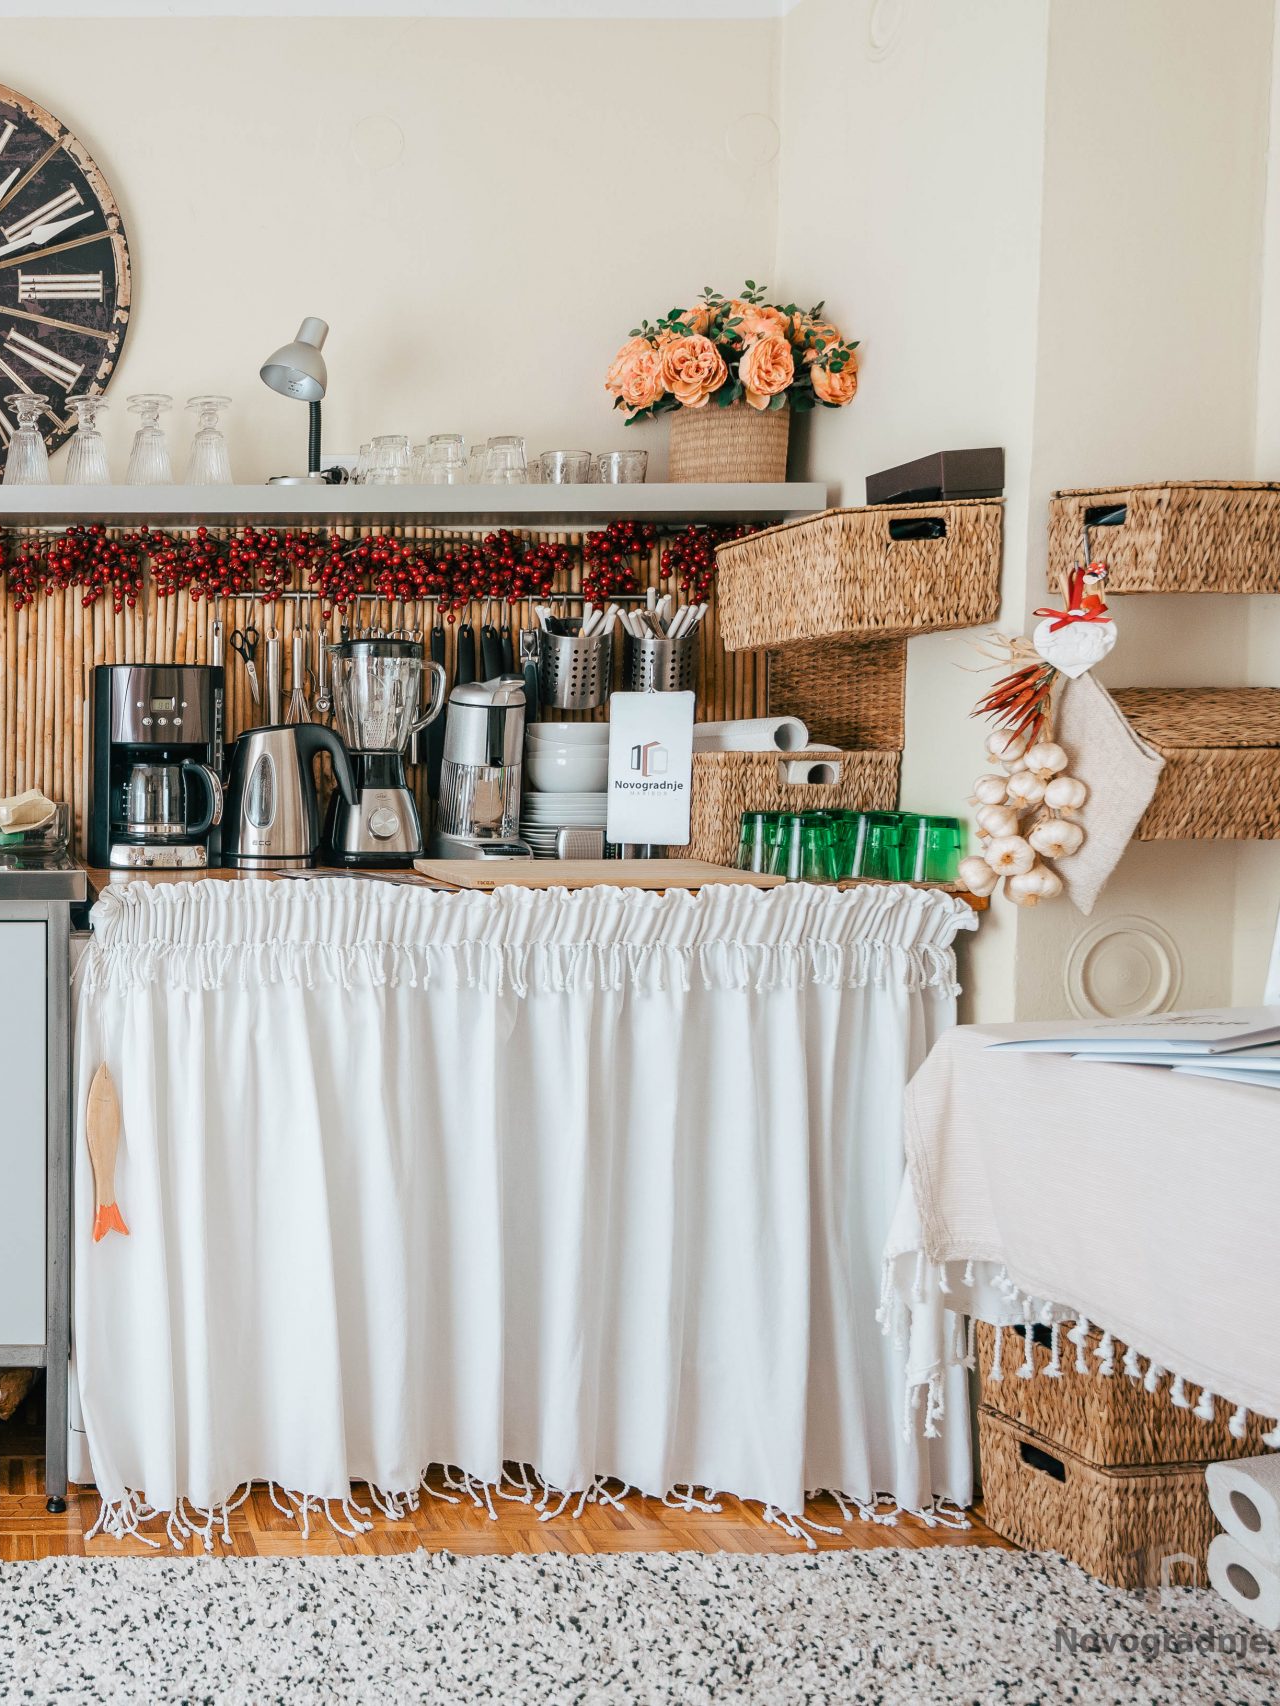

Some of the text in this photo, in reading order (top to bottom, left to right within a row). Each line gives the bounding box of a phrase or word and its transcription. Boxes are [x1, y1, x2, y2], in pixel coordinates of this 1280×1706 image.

[0, 183, 85, 243] II
[18, 269, 103, 303] III
[3, 327, 85, 394] IV
[615, 781, 684, 791] Novogradnje
